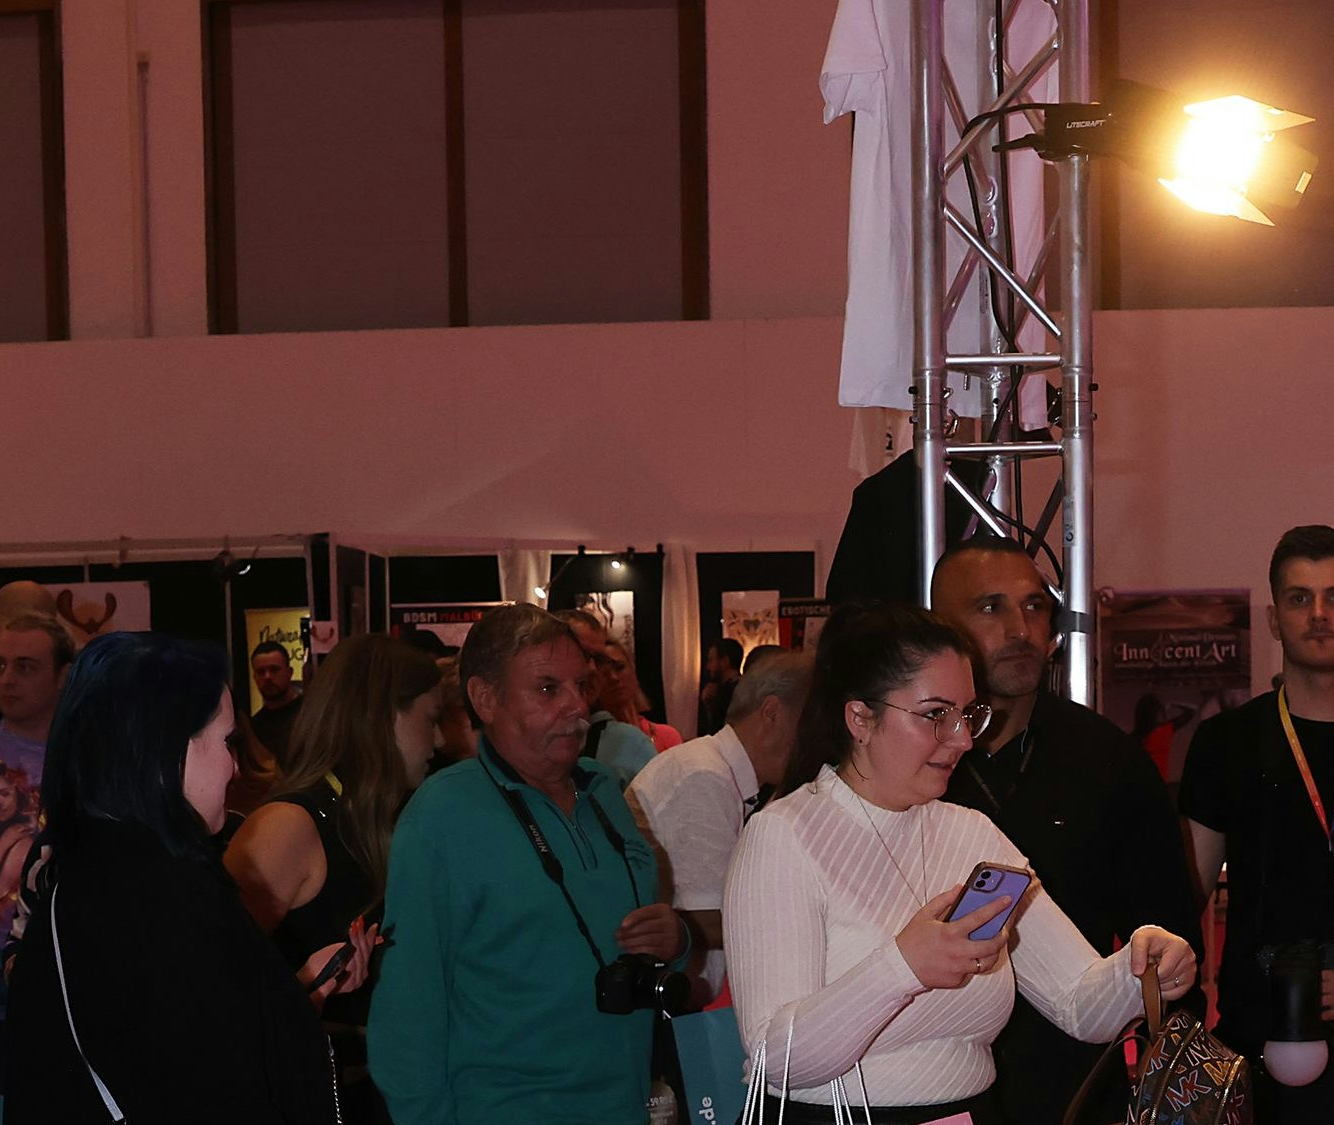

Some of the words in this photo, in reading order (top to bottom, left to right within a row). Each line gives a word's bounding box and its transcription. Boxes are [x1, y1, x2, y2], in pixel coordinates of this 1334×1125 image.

[403, 611, 437, 623] BDSM
[1203, 641, 1236, 664] Art
[528, 803, 549, 854] Nikon
[1165, 1069, 1212, 1113] MK
